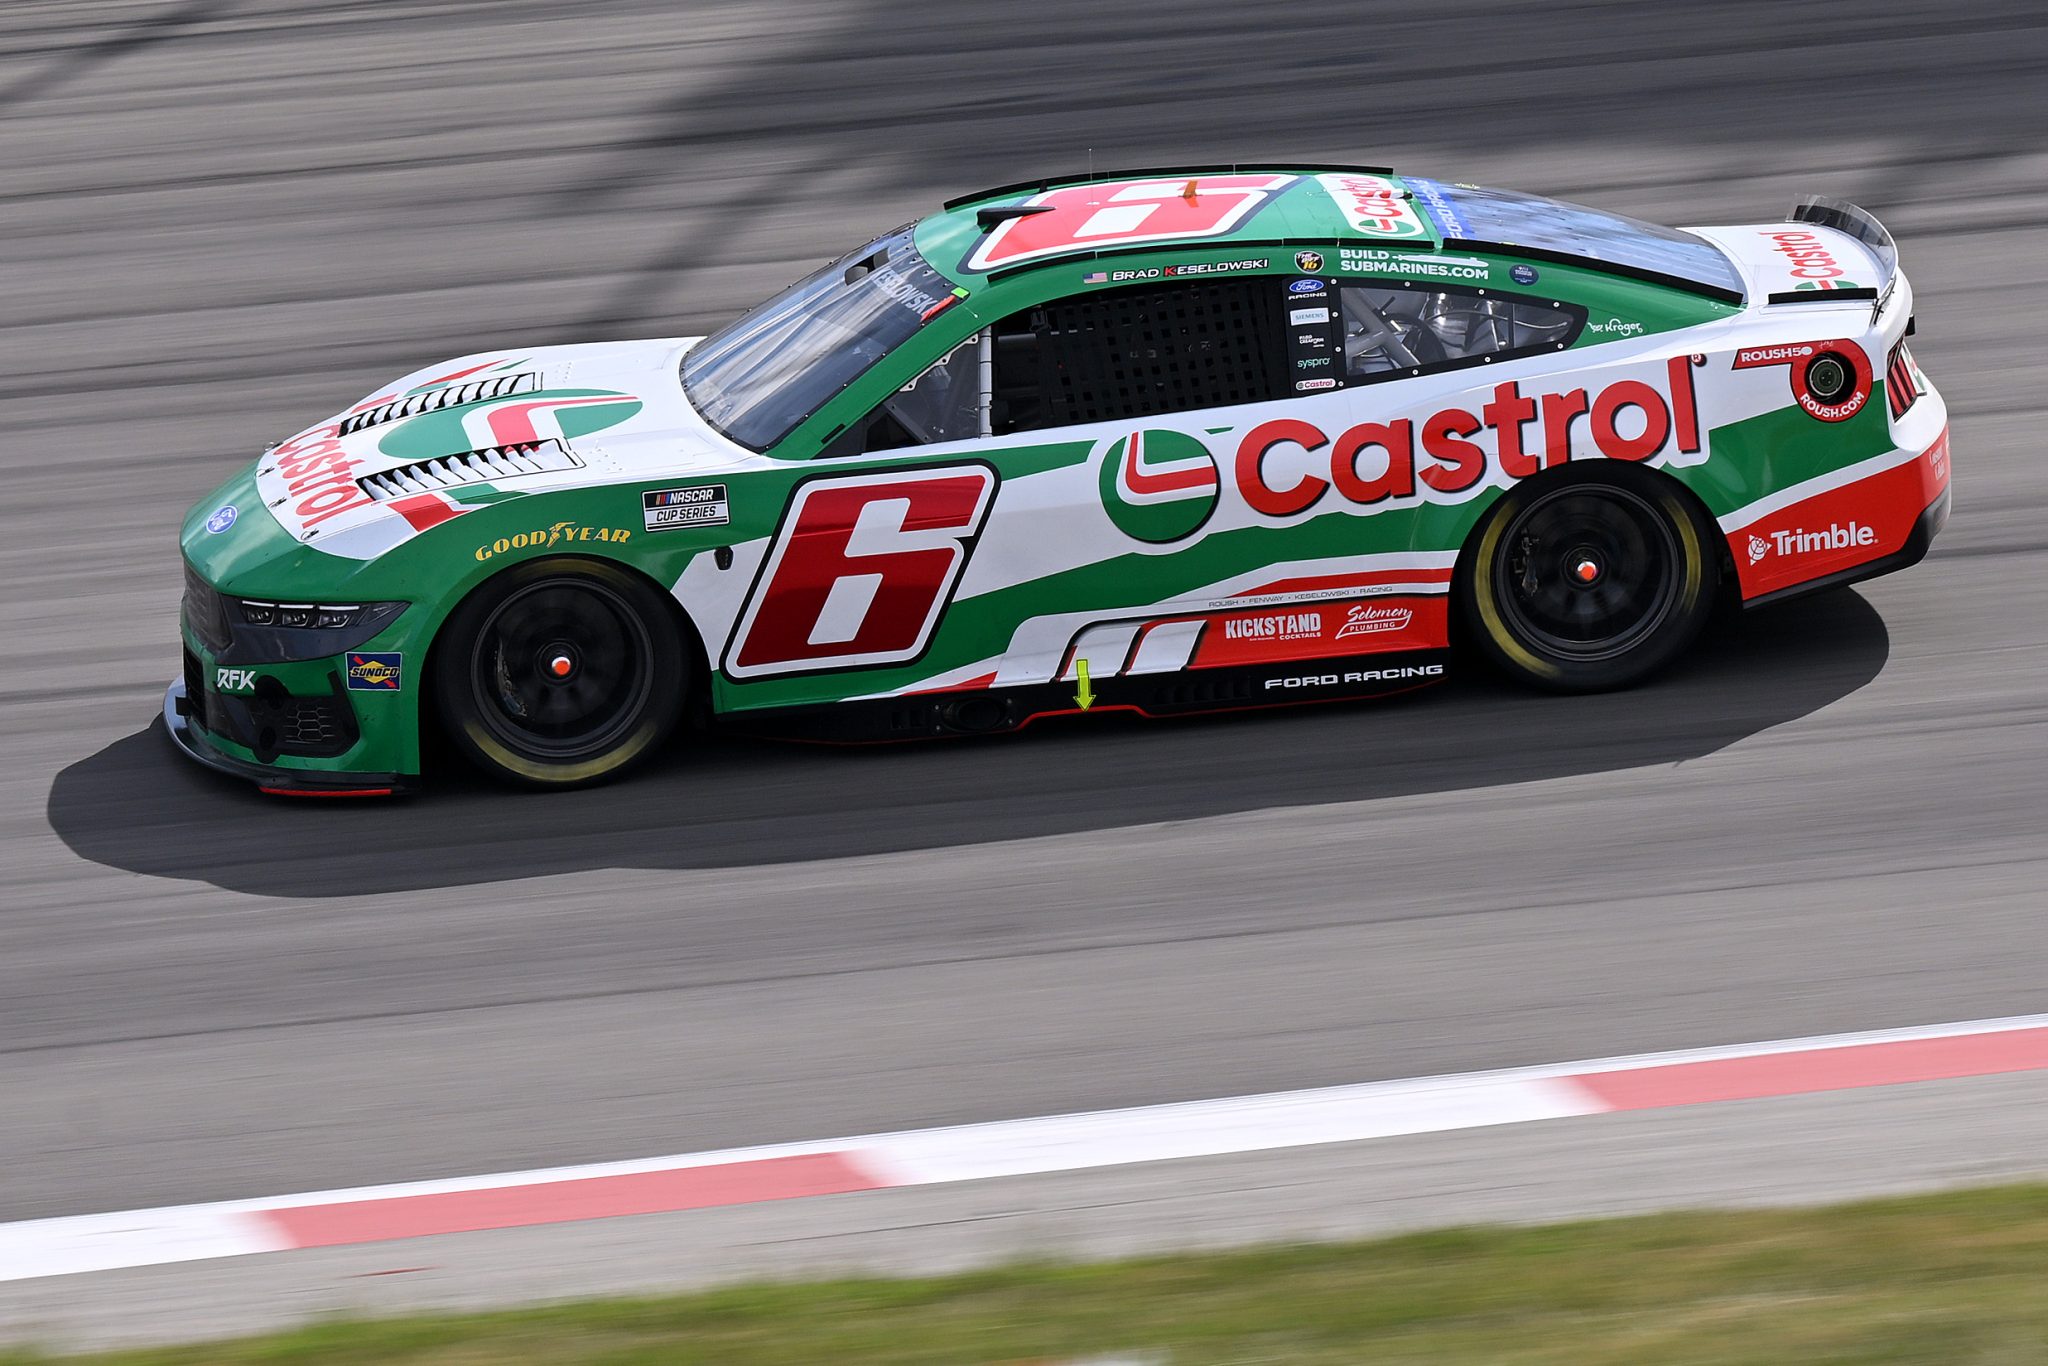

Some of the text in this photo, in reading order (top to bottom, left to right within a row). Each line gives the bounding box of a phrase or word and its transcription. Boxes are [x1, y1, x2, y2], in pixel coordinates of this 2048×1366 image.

[1340, 249, 1389, 260] BUILD
[1758, 232, 1844, 278] Castrol
[1112, 258, 1268, 281] BRAD KESELOWSKI
[1303, 261, 1317, 270] 16
[1341, 261, 1489, 280] SUBMARINES.COM
[1296, 281, 1317, 290] Ford
[1288, 292, 1327, 300] RACING
[1605, 318, 1641, 336] Kroger
[1297, 358, 1330, 369] syspro
[1304, 379, 1333, 388] Castrol
[1801, 391, 1865, 418] ROUSH.COM
[1235, 355, 1700, 516] Castrol
[273, 424, 375, 529] Castrol
[669, 488, 714, 504] NASCAR
[656, 505, 717, 522] CUP SERIES
[1770, 521, 1874, 556] Trimble
[726, 465, 995, 678] 6
[1208, 585, 1393, 607] ROUSH FENWAY KESELOWSKI RACING
[1347, 605, 1413, 622] Solomon
[1225, 613, 1321, 639] KICKSTAND
[1349, 621, 1396, 632] PLUMBING
[1279, 631, 1322, 641] COCKTAILS
[217, 668, 256, 690] RFK
[351, 667, 399, 677] SUNOCO
[1265, 664, 1443, 689] FORD RACING
